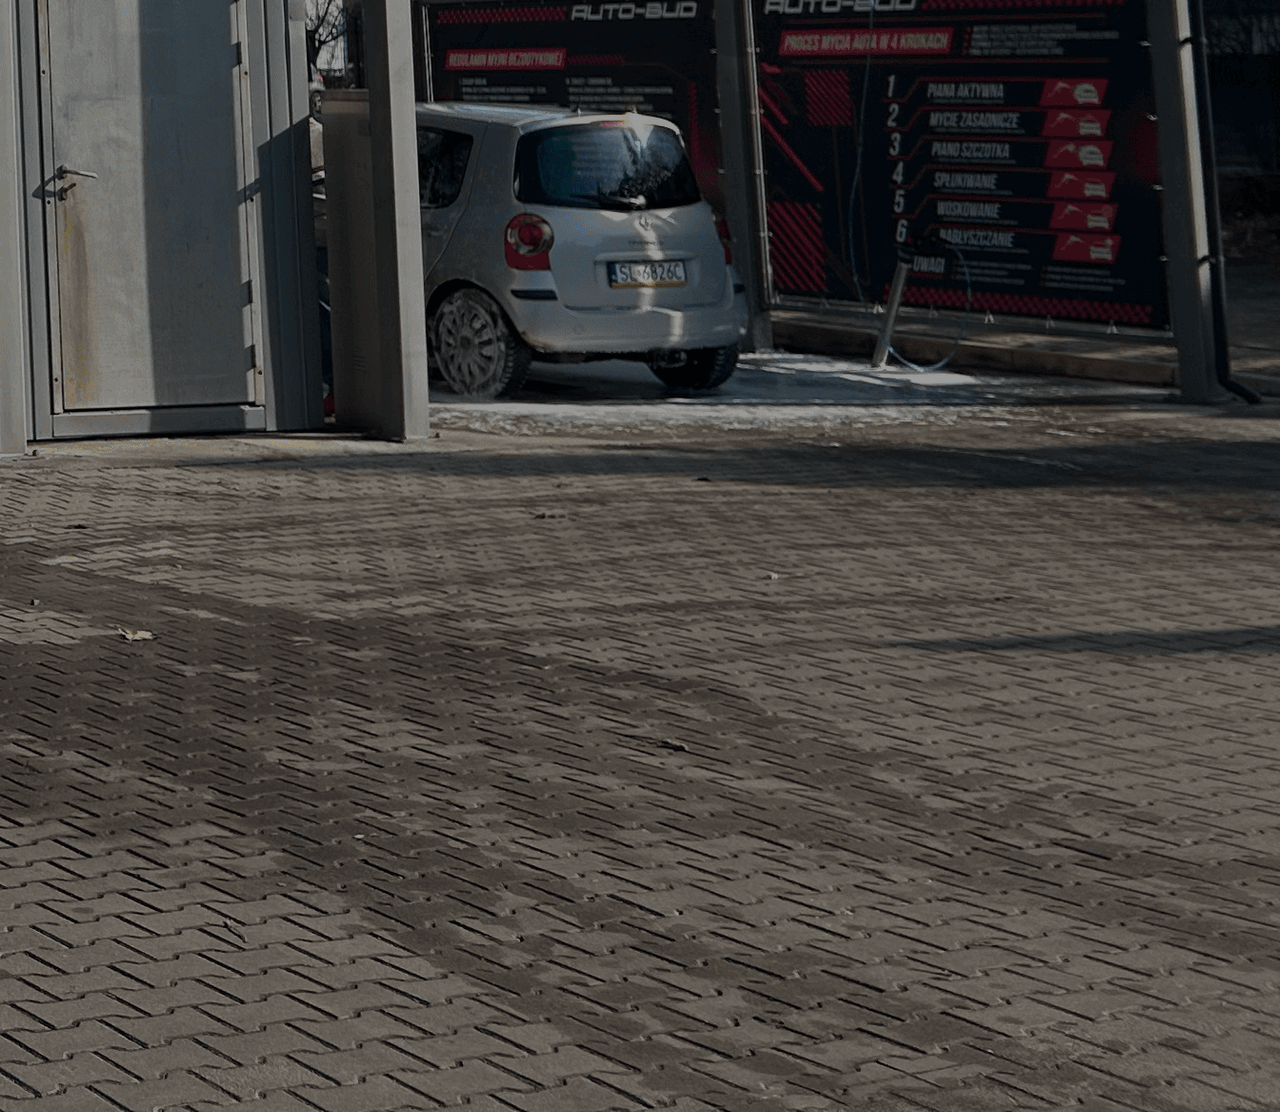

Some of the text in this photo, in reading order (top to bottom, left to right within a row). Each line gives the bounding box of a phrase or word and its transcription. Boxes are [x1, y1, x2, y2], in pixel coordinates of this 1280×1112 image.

[570, 0, 698, 21] AUTO-BUD
[887, 74, 1004, 98] 1 PIANA AKTYWNA
[886, 103, 1021, 129] 2 MYCIE ZASADNICZE
[889, 132, 901, 156] 3
[891, 162, 904, 185] 4
[893, 190, 905, 213] 5
[896, 219, 908, 243] 6
[619, 264, 637, 282] SL
